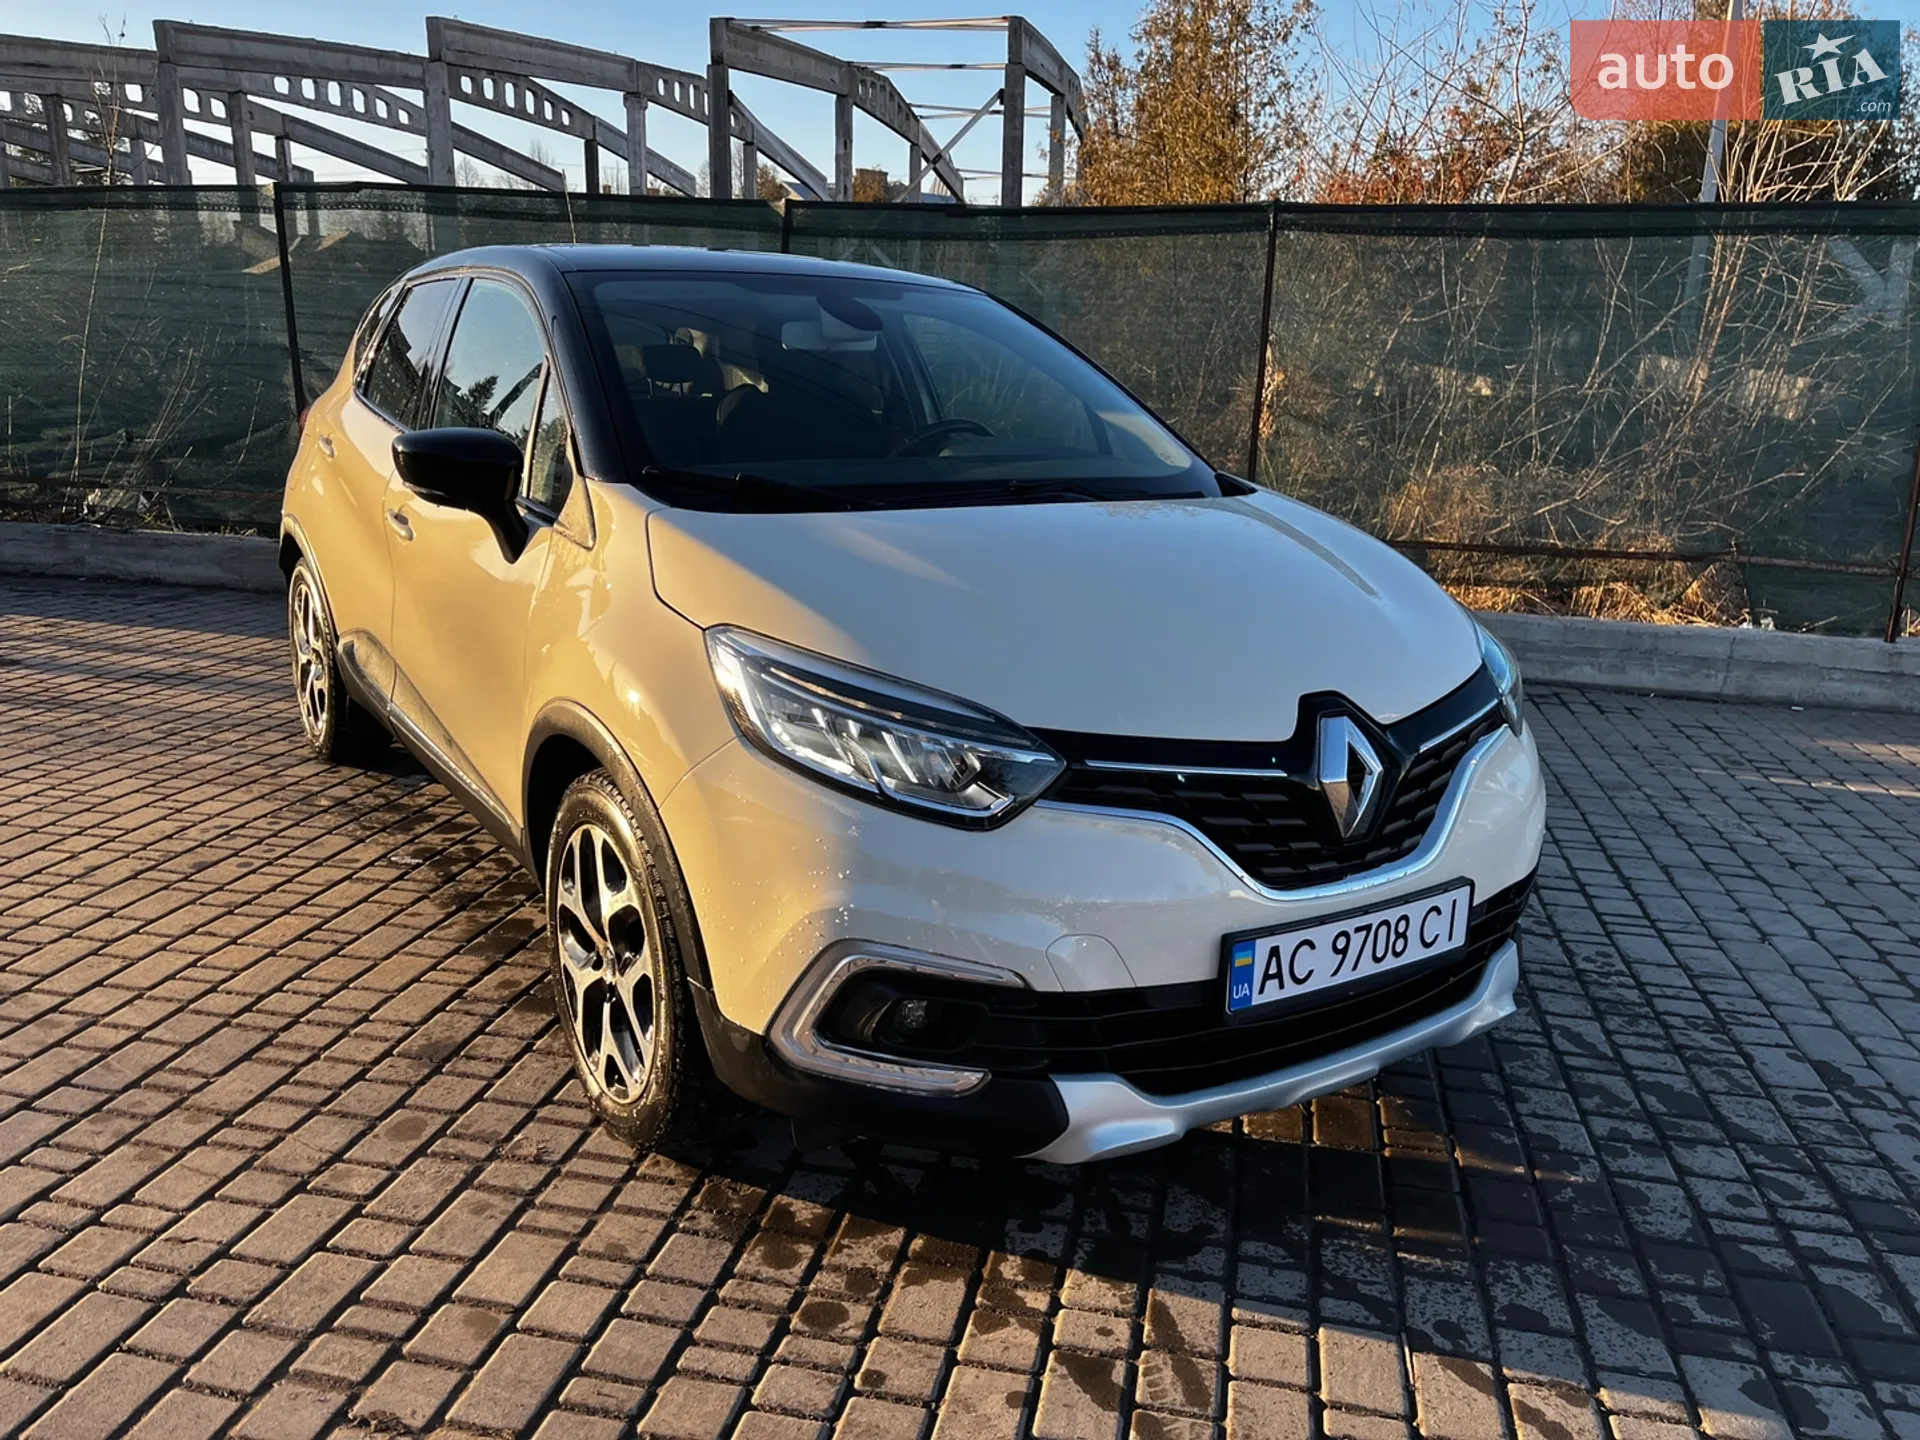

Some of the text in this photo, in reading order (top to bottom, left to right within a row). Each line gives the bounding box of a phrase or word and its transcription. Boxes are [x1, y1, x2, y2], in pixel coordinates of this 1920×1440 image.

[1258, 898, 1457, 995] AC 9708 CI
[1232, 983, 1250, 999] UA
